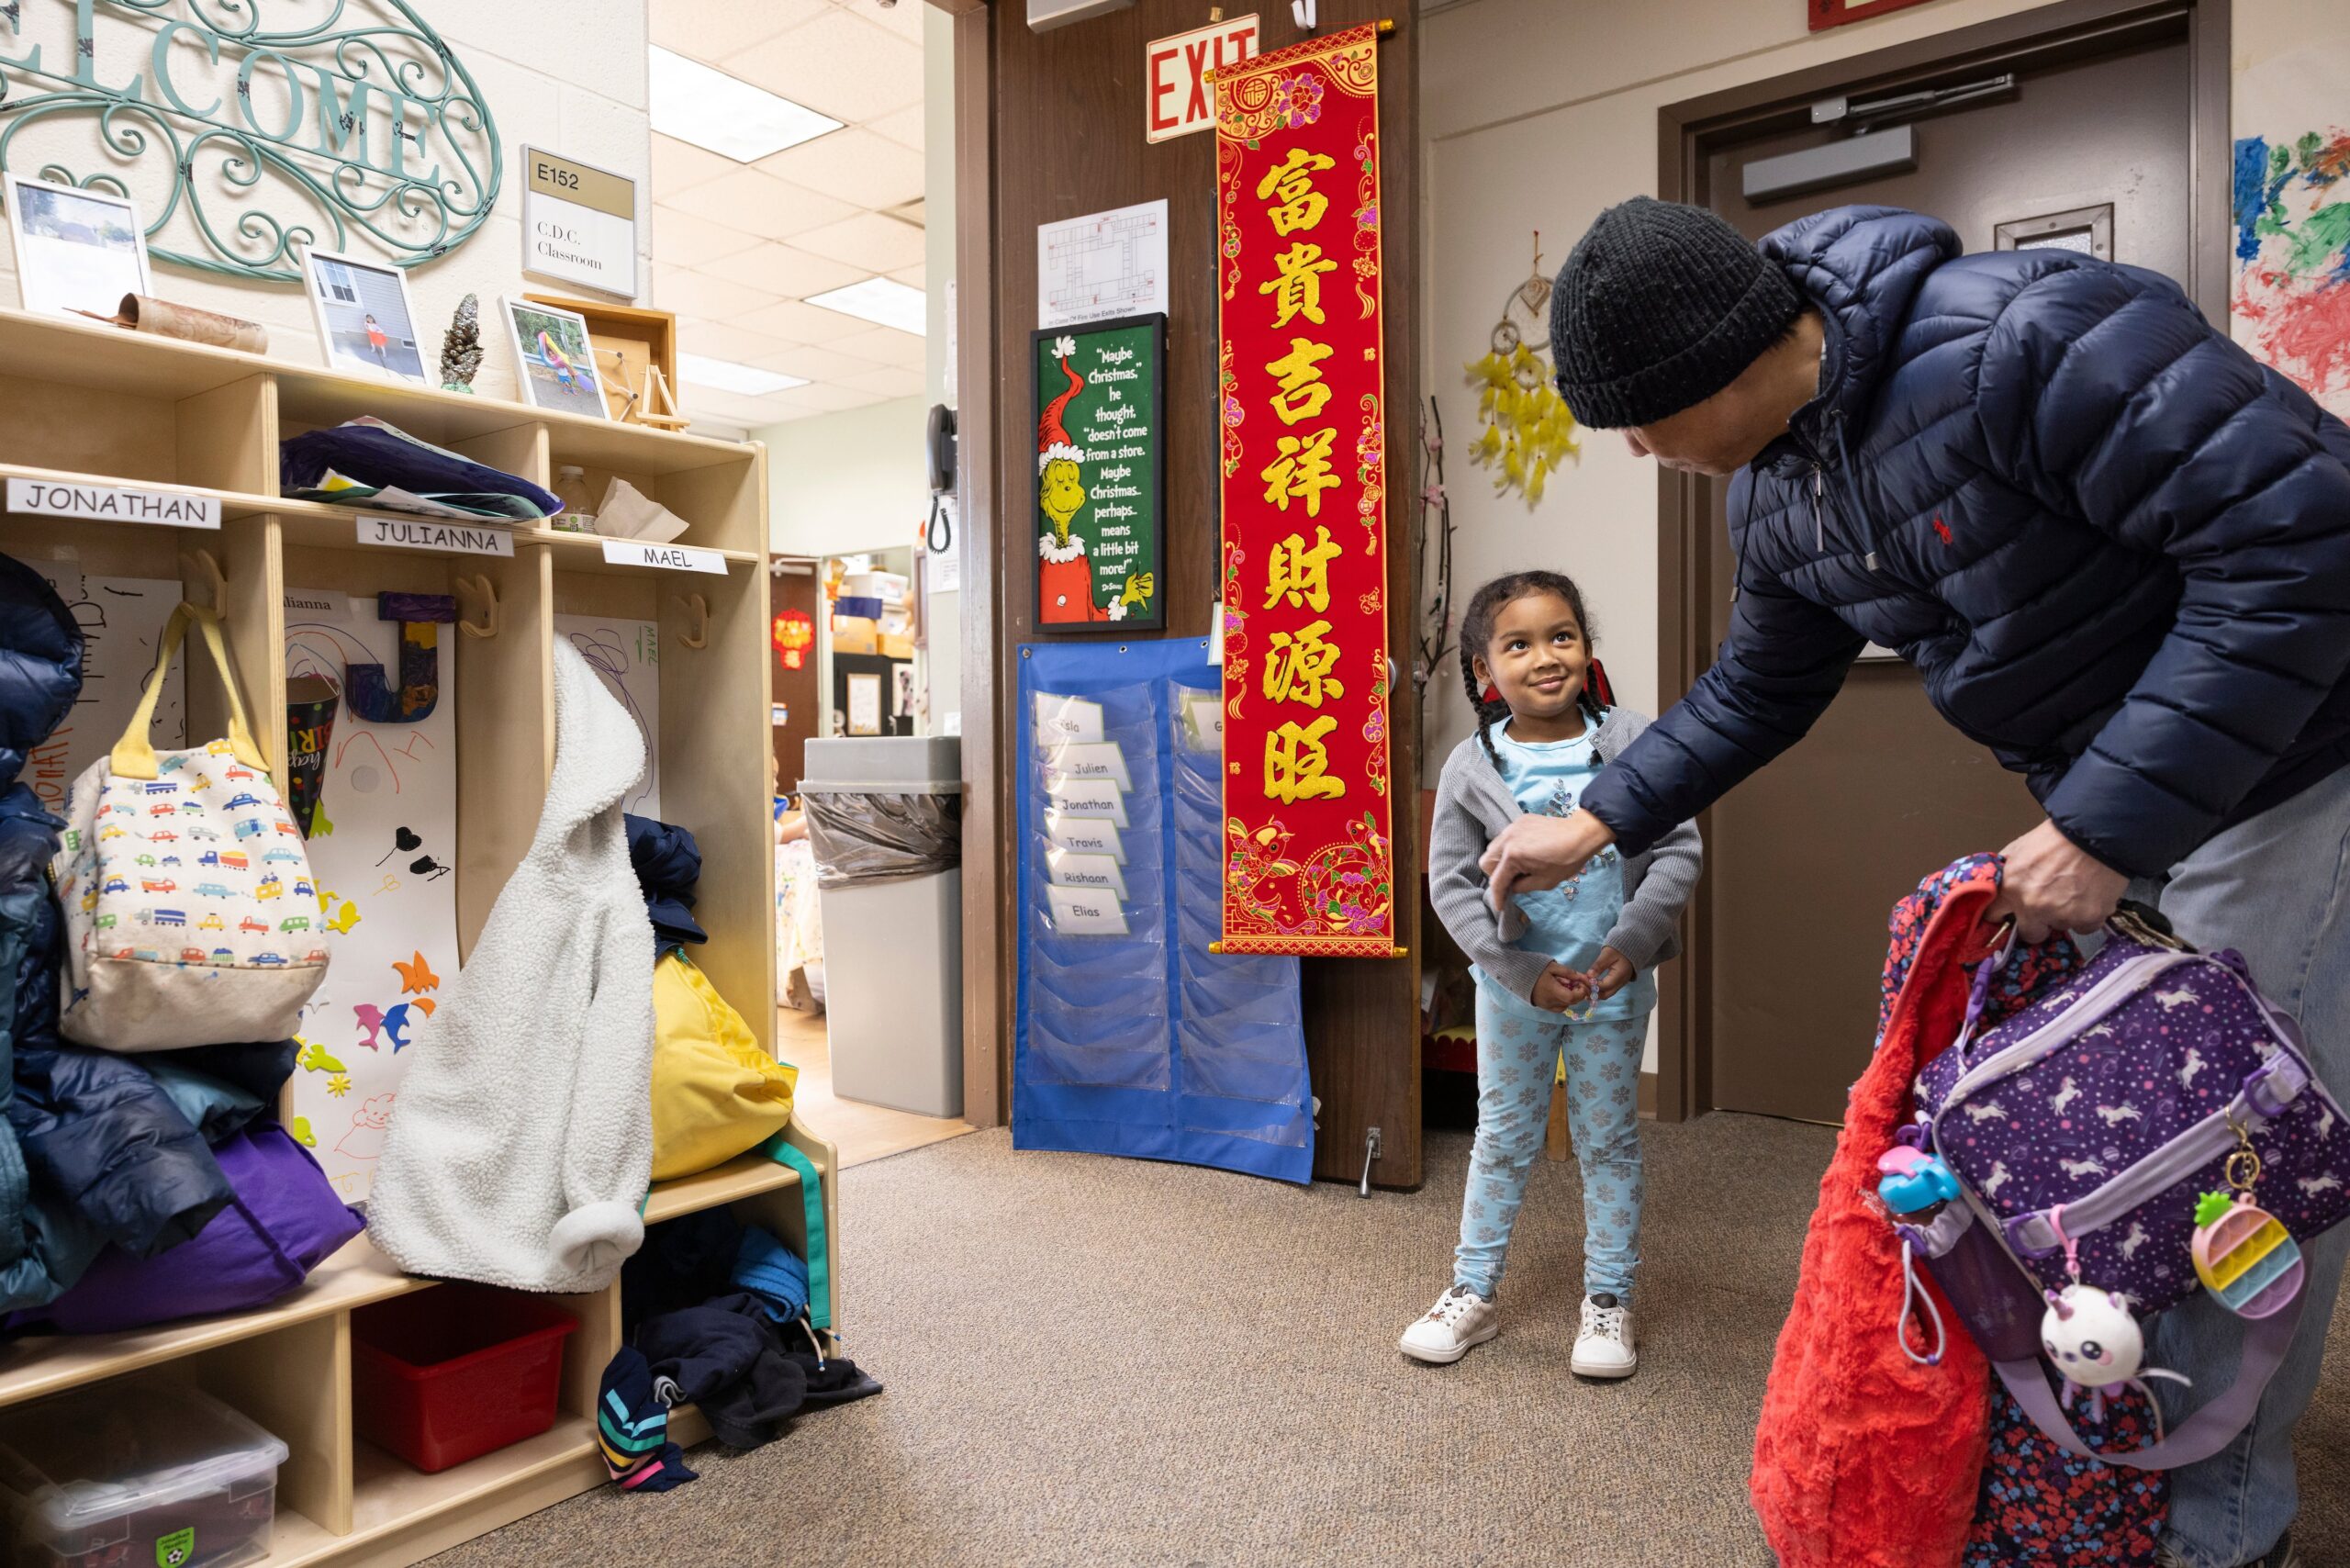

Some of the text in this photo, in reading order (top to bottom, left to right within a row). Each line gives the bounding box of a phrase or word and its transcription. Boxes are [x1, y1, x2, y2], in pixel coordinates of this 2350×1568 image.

[538, 163, 579, 190] E152
[537, 221, 581, 245] C.D.C.
[537, 241, 602, 270] Classroom
[1109, 386, 1122, 401] he
[1123, 426, 1147, 438] come
[1086, 444, 1146, 462] from a store.
[1101, 464, 1131, 482] Maybe
[1256, 147, 1347, 805] 富貴吉祥財源旺
[26, 484, 207, 522] JONATHAN
[375, 521, 499, 551] JULIANNA
[1102, 525, 1131, 537] means
[643, 548, 693, 568] MAEL
[1093, 541, 1139, 557] a little bit
[644, 625, 658, 667] MAEL
[1074, 763, 1108, 774] Julien
[1063, 799, 1114, 810] Jonathan
[1067, 837, 1103, 847] Travis
[1064, 872, 1109, 883] Rishaan
[1073, 905, 1100, 917] Elias
